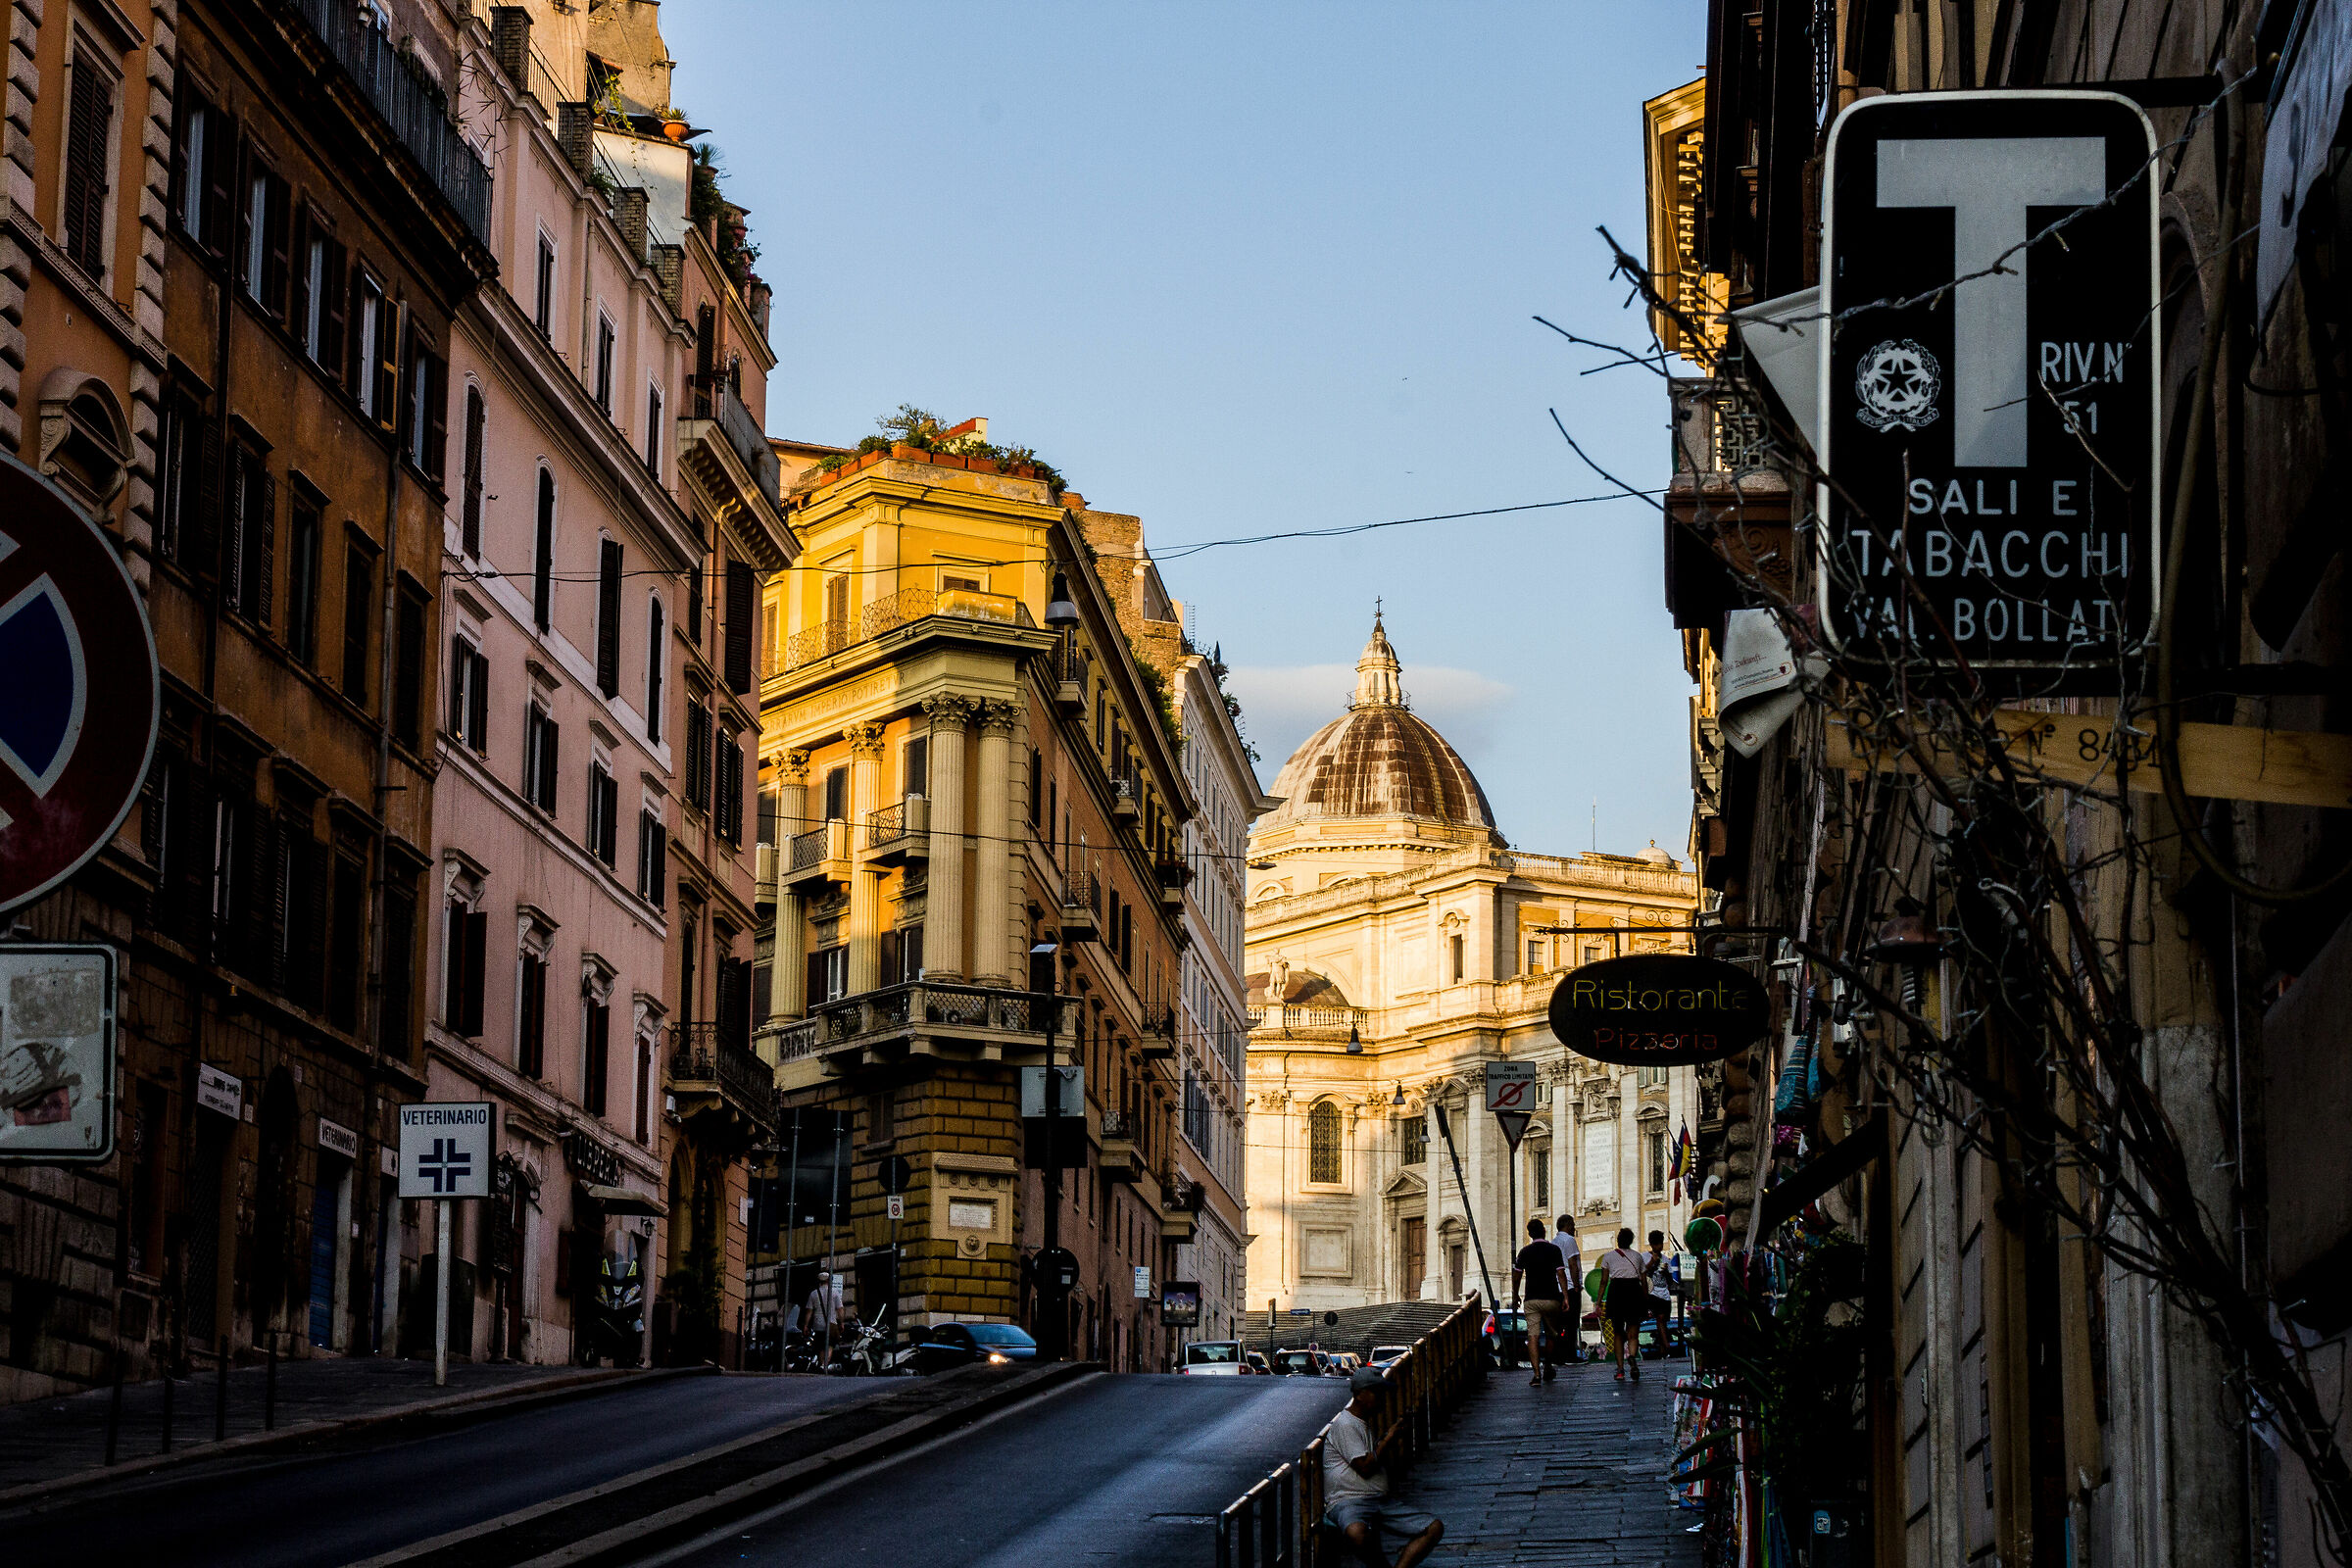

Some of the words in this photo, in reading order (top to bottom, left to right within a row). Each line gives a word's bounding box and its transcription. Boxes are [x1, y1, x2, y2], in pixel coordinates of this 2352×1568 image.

[1876, 136, 2106, 467] T
[2063, 400, 2097, 434] 51
[1909, 477, 2017, 515] SALI
[2052, 479, 2078, 515] E
[1851, 529, 2128, 578] TABACCHI
[1573, 979, 1748, 1011] Ristorante
[1593, 1027, 1718, 1051] Pizzeria
[403, 1108, 487, 1125] VETERINARIO
[321, 1123, 356, 1153] VETERINARIO
